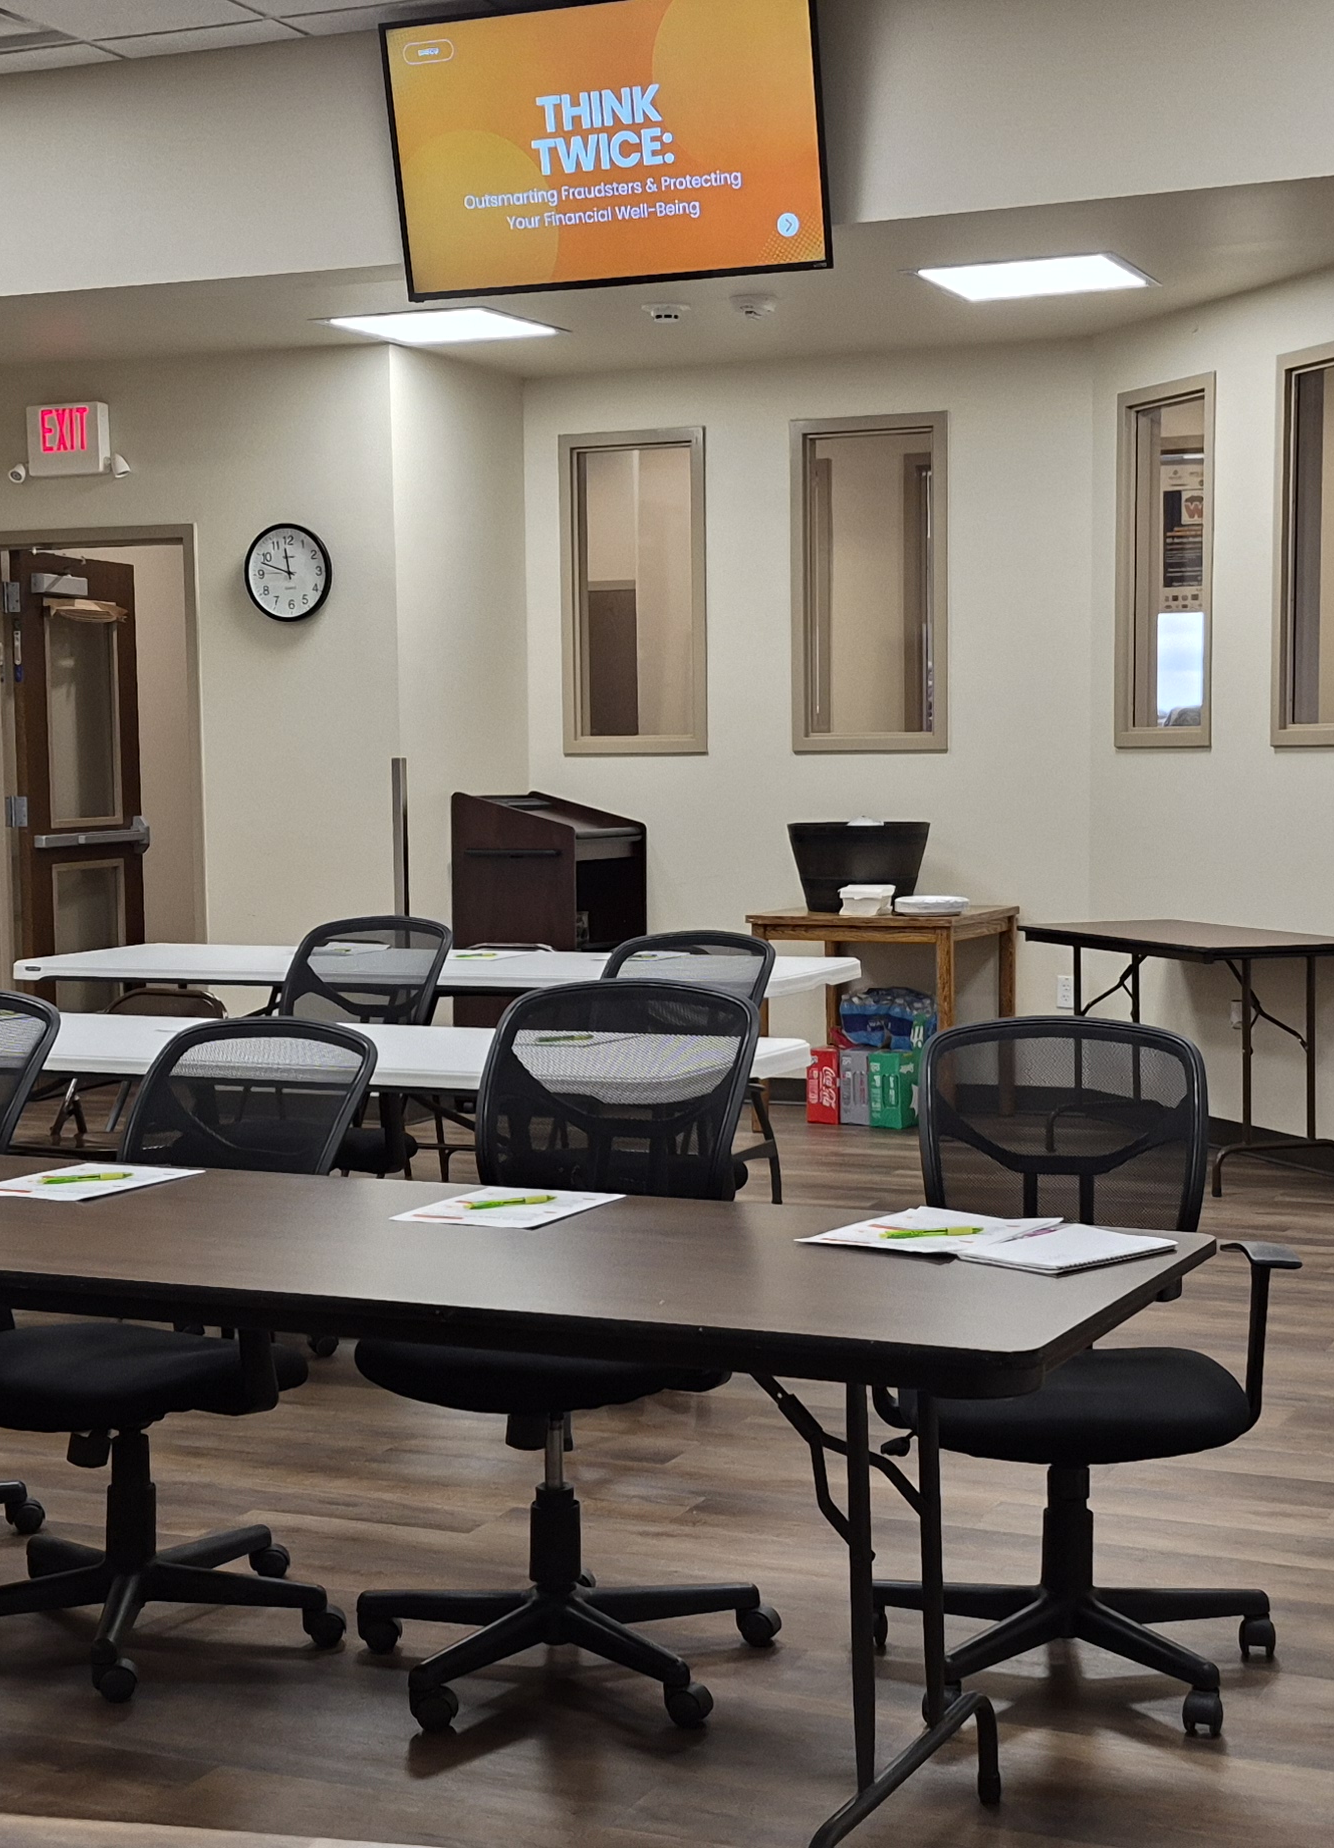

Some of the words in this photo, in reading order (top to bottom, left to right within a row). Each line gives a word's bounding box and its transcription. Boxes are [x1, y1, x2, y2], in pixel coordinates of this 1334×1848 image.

[535, 83, 663, 133] THINK
[531, 127, 675, 176] TWICE:
[463, 188, 558, 210] Outsmarting
[561, 181, 642, 200] Fraudsters
[645, 177, 658, 193] &
[661, 170, 742, 190] Protecting
[506, 214, 541, 230] Your
[544, 206, 612, 227] Financial
[615, 199, 701, 219] Well-Being
[39, 405, 89, 453] EXIT
[272, 541, 280, 551] 11
[283, 535, 294, 546] 12
[262, 551, 272, 563] 10
[310, 549, 318, 560] 2
[257, 569, 265, 580] 9
[315, 565, 323, 577] 3
[262, 585, 270, 596] 8
[312, 583, 319, 593] 4
[273, 595, 280, 606] 7
[288, 599, 296, 610] 6
[301, 593, 309, 605] 5
